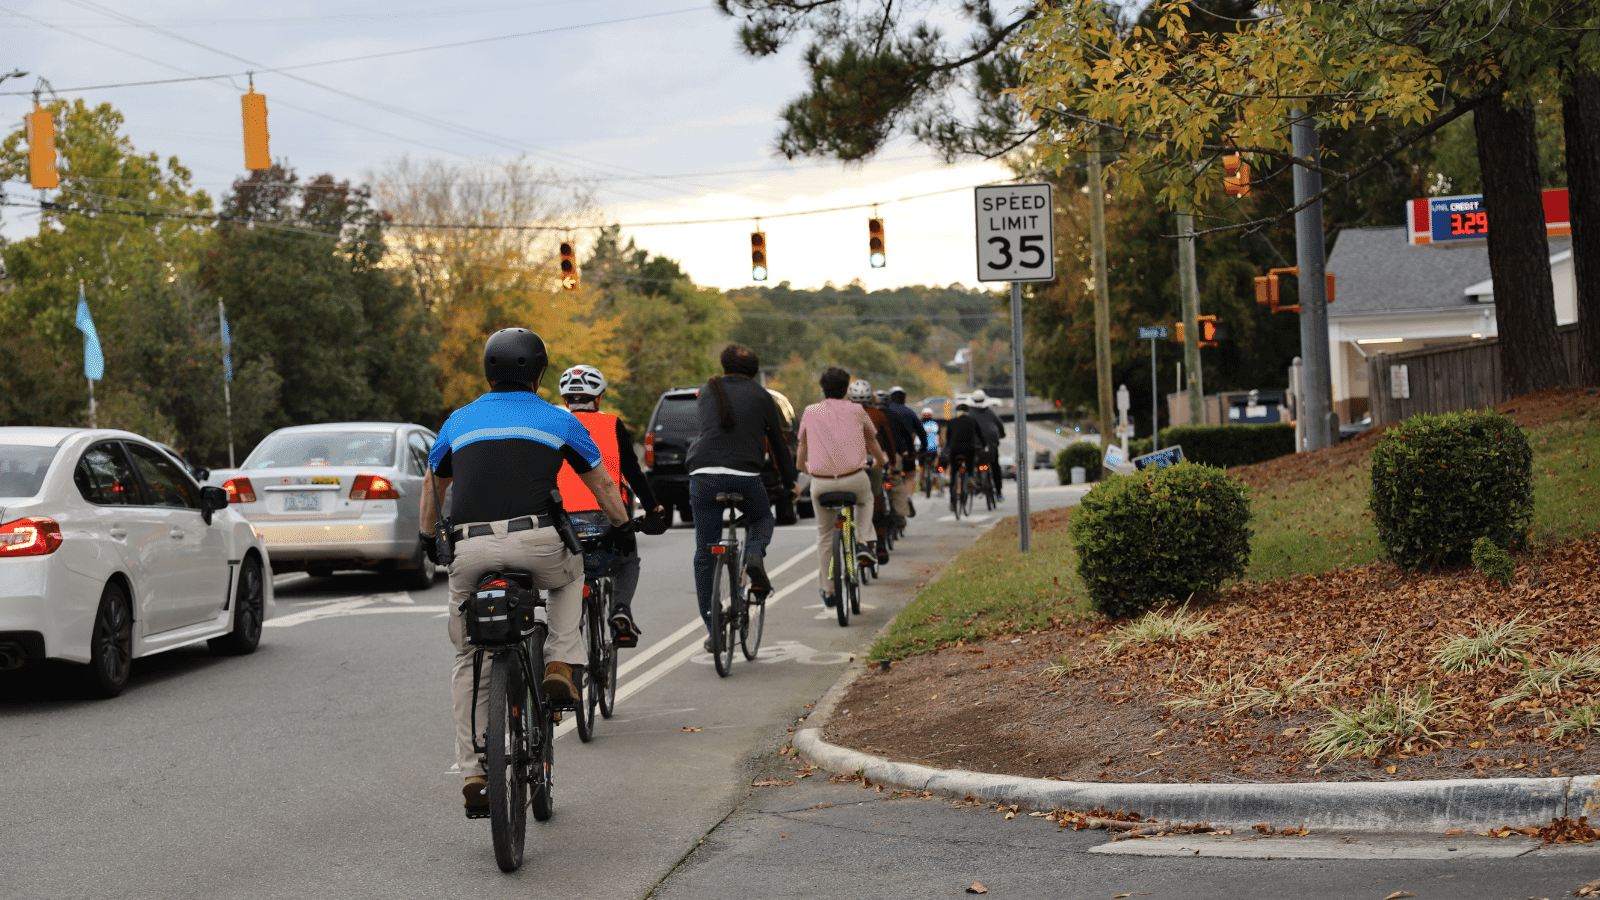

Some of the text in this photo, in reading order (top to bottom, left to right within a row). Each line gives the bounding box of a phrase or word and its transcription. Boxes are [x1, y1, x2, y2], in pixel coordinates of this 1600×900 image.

[982, 195, 1045, 212] SPEED
[1449, 201, 1479, 212] CREDIT
[990, 215, 1038, 231] LIMIT
[987, 234, 1045, 270] 35
